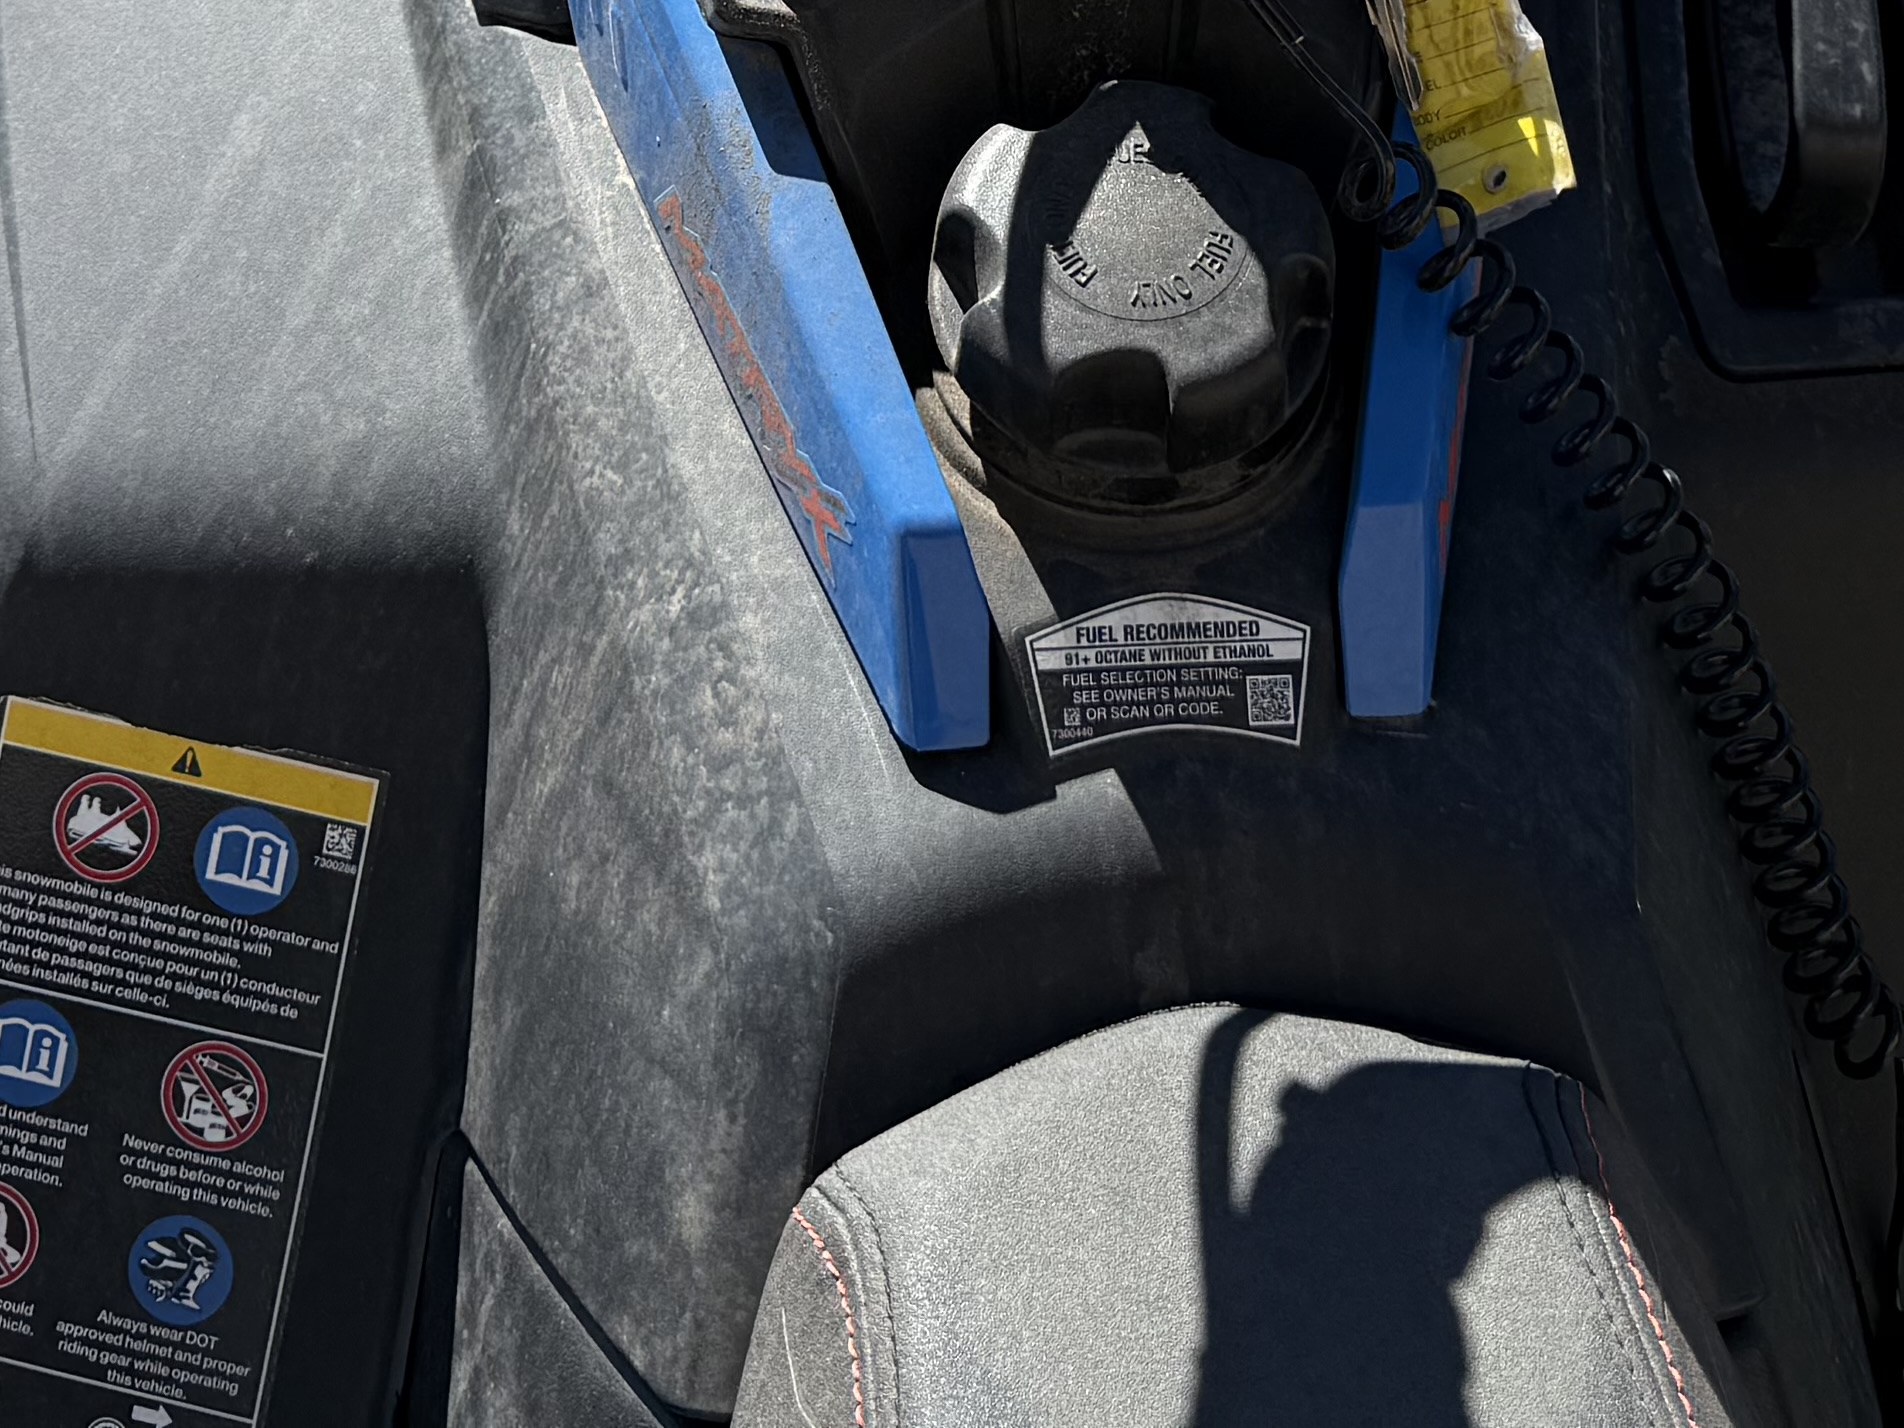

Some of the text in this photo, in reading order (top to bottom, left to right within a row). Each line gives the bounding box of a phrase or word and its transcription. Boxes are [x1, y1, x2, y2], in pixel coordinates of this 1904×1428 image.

[1189, 231, 1234, 280] FUEL
[1076, 621, 1261, 645] FUEL RECOMMENDED
[1062, 667, 1243, 687] FUEL SELECTION SETTING:
[1064, 644, 1274, 667] 91+ OCTANE WITHOUT ETHANOL
[1072, 685, 1235, 703] SEE OWNER'S MANUAL
[1086, 701, 1223, 720] OR SCAN QR CODE.
[14, 869, 99, 899] snowmobile
[99, 887, 113, 902] is
[113, 891, 180, 918] designed
[180, 905, 202, 922] for
[201, 913, 229, 929] one
[230, 917, 249, 936] (1)
[249, 924, 312, 947] operator
[311, 938, 340, 955] and
[37, 894, 120, 923] passengers
[120, 913, 138, 927] as
[140, 915, 177, 935] there
[177, 926, 201, 941] are
[202, 931, 241, 950] seats
[242, 941, 273, 958] with
[47, 912, 108, 938] installed
[108, 929, 127, 943] on
[128, 931, 152, 948] the
[152, 939, 241, 969] snowmobile.
[12, 925, 88, 953] motoneige
[87, 943, 111, 958] est
[164, 960, 200, 977] pour
[200, 969, 219, 982] un
[220, 970, 239, 989] (1)
[239, 977, 322, 1005] conducteur
[31, 946, 50, 962] de
[50, 953, 124, 979] passagers
[125, 970, 153, 985] que
[153, 974, 173, 991] de
[279, 1003, 299, 1019] de
[90, 980, 115, 995] sur
[114, 986, 170, 1008] celle-ci.
[8, 1108, 89, 1137] understand
[39, 1134, 67, 1151] and
[11, 1143, 64, 1169] Manual
[119, 1154, 281, 1201] or drugs before or while
[122, 1133, 285, 1183] Never consume alcohol
[123, 1173, 273, 1218] operating this vehicle.
[55, 1320, 251, 1377] approved helmet and proper
[96, 1309, 219, 1350] Always wear DOT
[57, 1338, 239, 1397] riding gear while operating
[106, 1369, 187, 1400] this vehicle.
